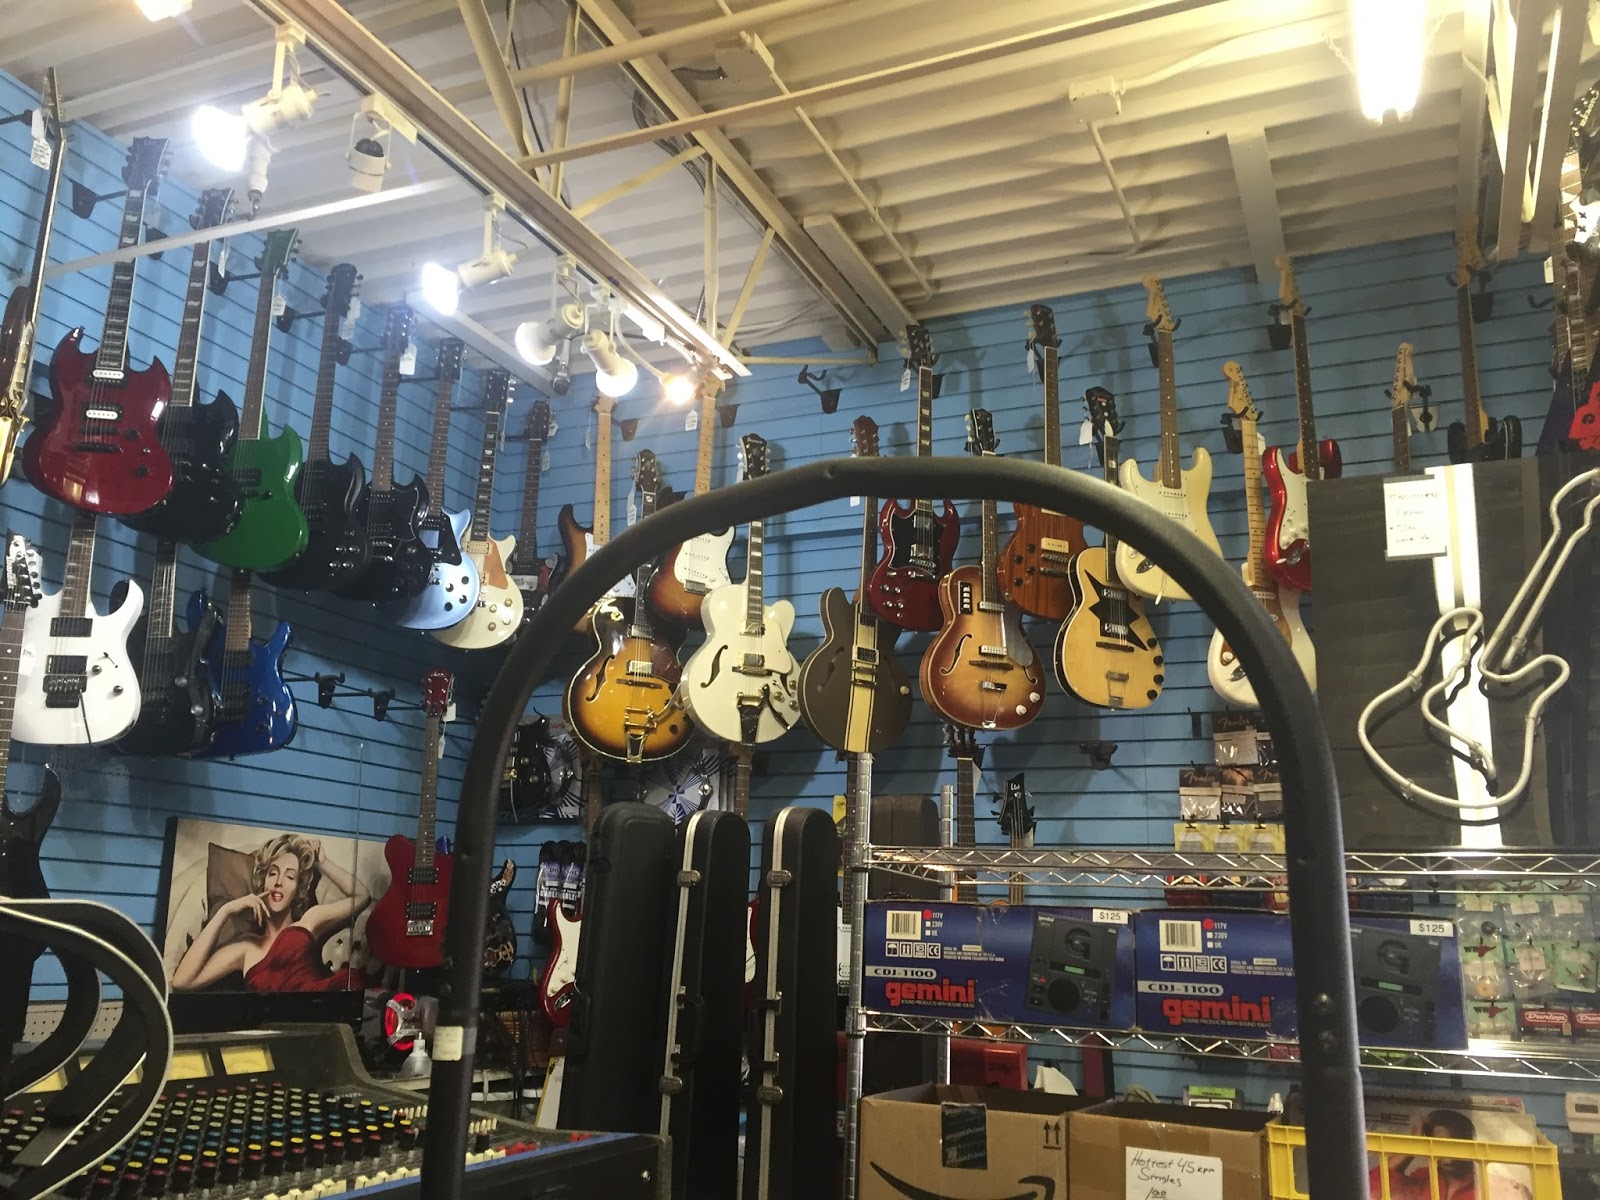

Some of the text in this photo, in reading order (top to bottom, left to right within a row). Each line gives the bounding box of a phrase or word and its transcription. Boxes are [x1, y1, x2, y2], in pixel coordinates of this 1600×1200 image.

[1099, 911, 1121, 920] $125
[1418, 923, 1444, 933] $125
[874, 967, 934, 978] CDJ-1100
[885, 976, 975, 1007] gemini
[1148, 983, 1220, 994] CDJ-1100
[1162, 994, 1272, 1026] gemini
[1527, 1012, 1566, 1023] Dunlop
[1177, 1158, 1195, 1174] 45
[1137, 1167, 1182, 1187] Singles
